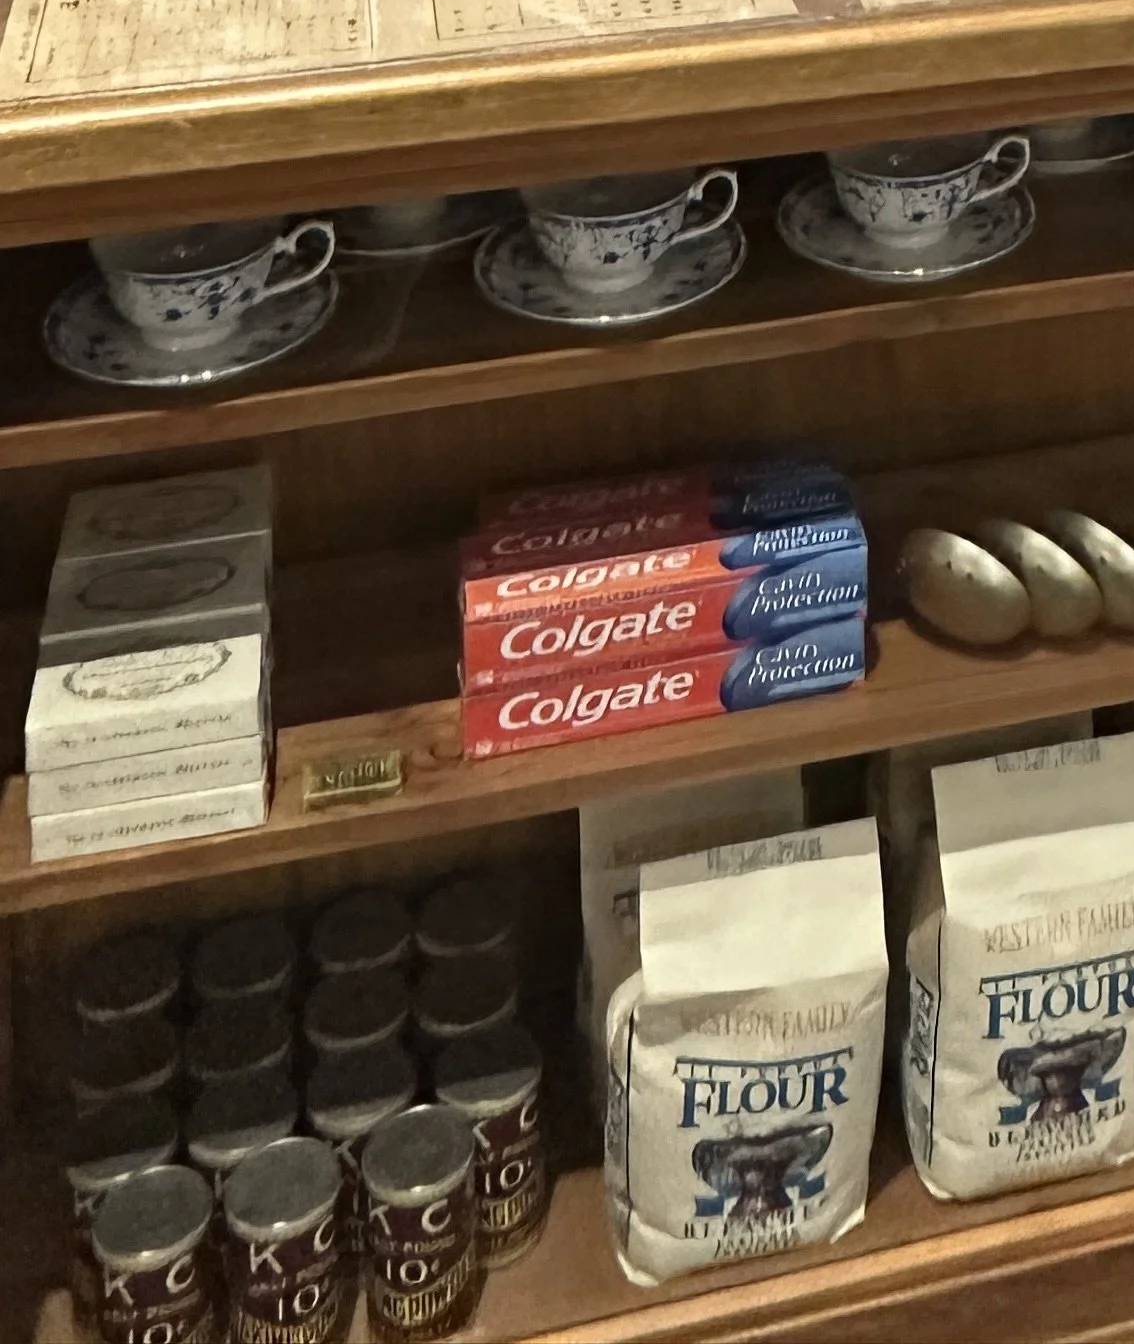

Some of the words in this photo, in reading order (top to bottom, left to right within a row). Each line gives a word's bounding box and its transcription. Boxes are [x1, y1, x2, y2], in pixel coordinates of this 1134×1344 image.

[491, 513, 682, 555] Colgate
[497, 551, 693, 598] Colgate
[751, 584, 859, 616] Protection
[500, 600, 698, 660] Colgate
[748, 653, 855, 687] Protection
[499, 670, 695, 731] Colgate
[675, 1064, 851, 1129] FLOUR
[421, 1197, 452, 1234] C
[249, 1242, 283, 1275] K
[313, 1213, 336, 1254] C
[103, 1264, 135, 1307] K
[165, 1255, 197, 1294] C
